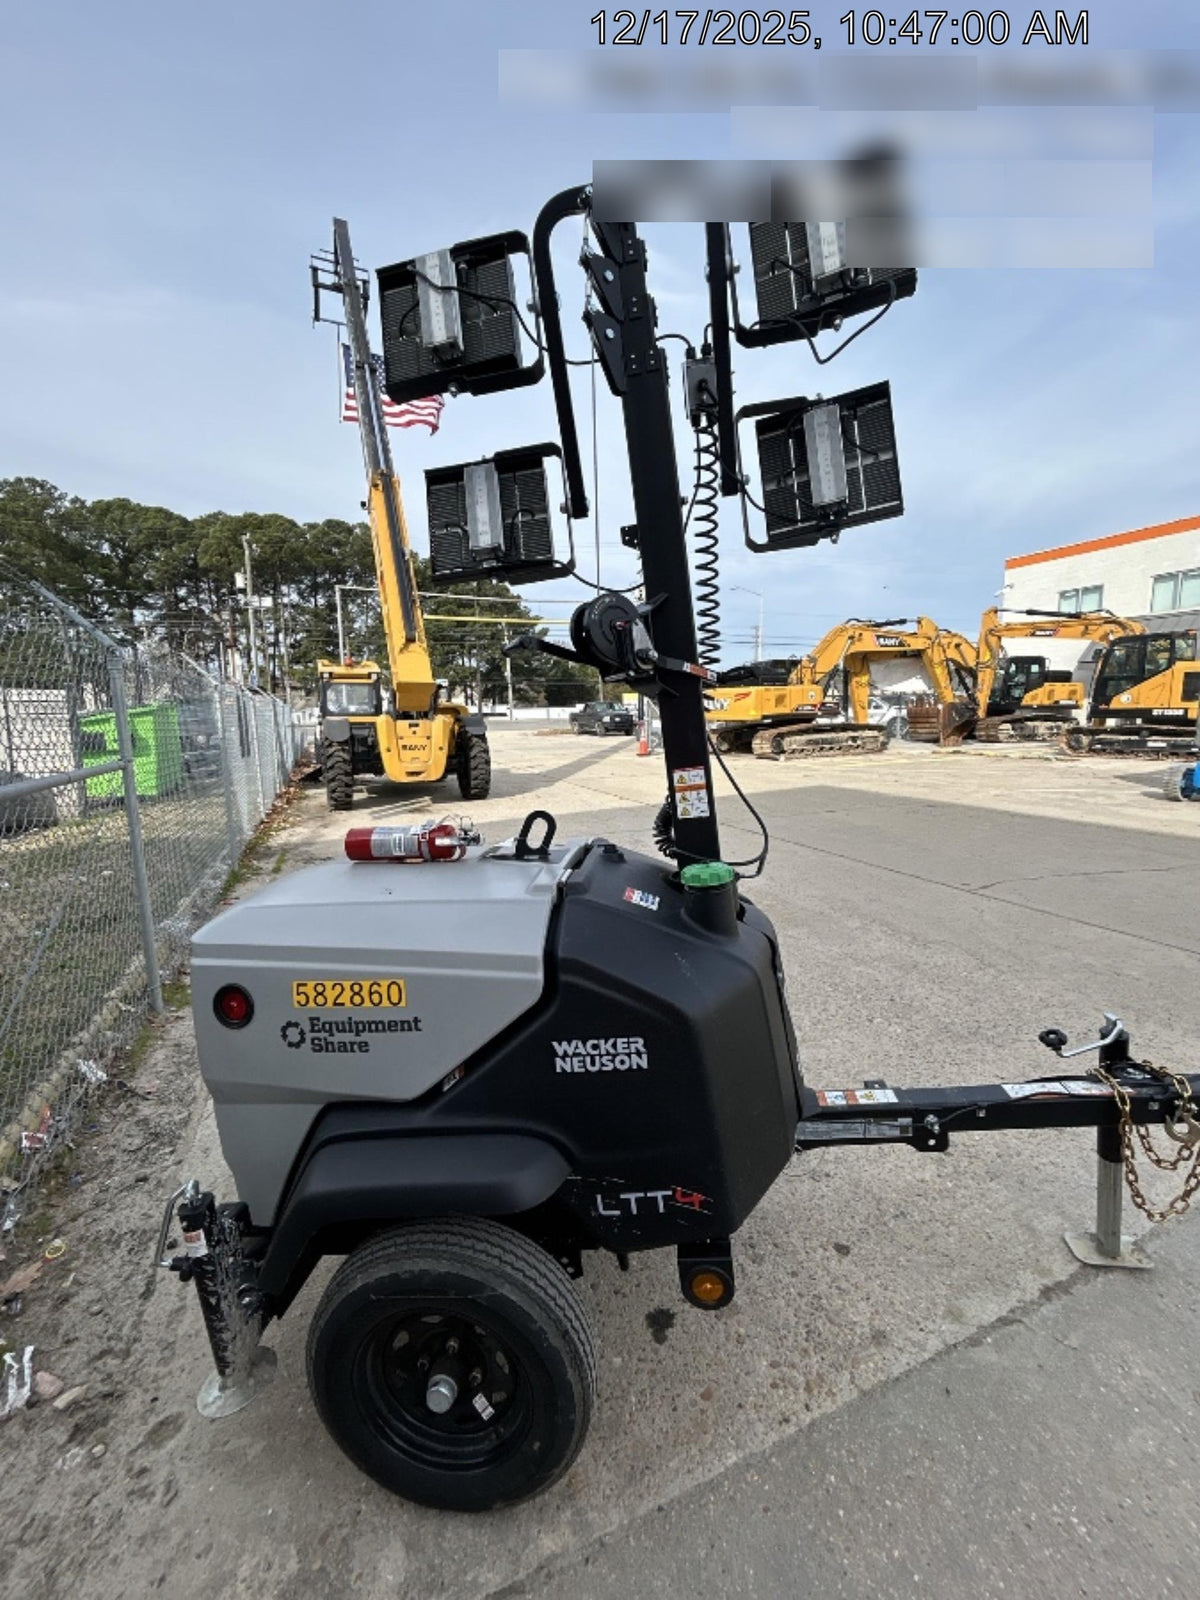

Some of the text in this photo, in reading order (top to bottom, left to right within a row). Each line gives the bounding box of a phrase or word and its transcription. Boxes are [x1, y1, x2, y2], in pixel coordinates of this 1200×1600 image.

[296, 981, 403, 1007] 582860
[308, 1016, 422, 1037] Equipment
[310, 1036, 370, 1053] Share
[551, 1037, 647, 1056] WACKER
[555, 1053, 648, 1073] NEUSON
[596, 1187, 705, 1216] LTT4
